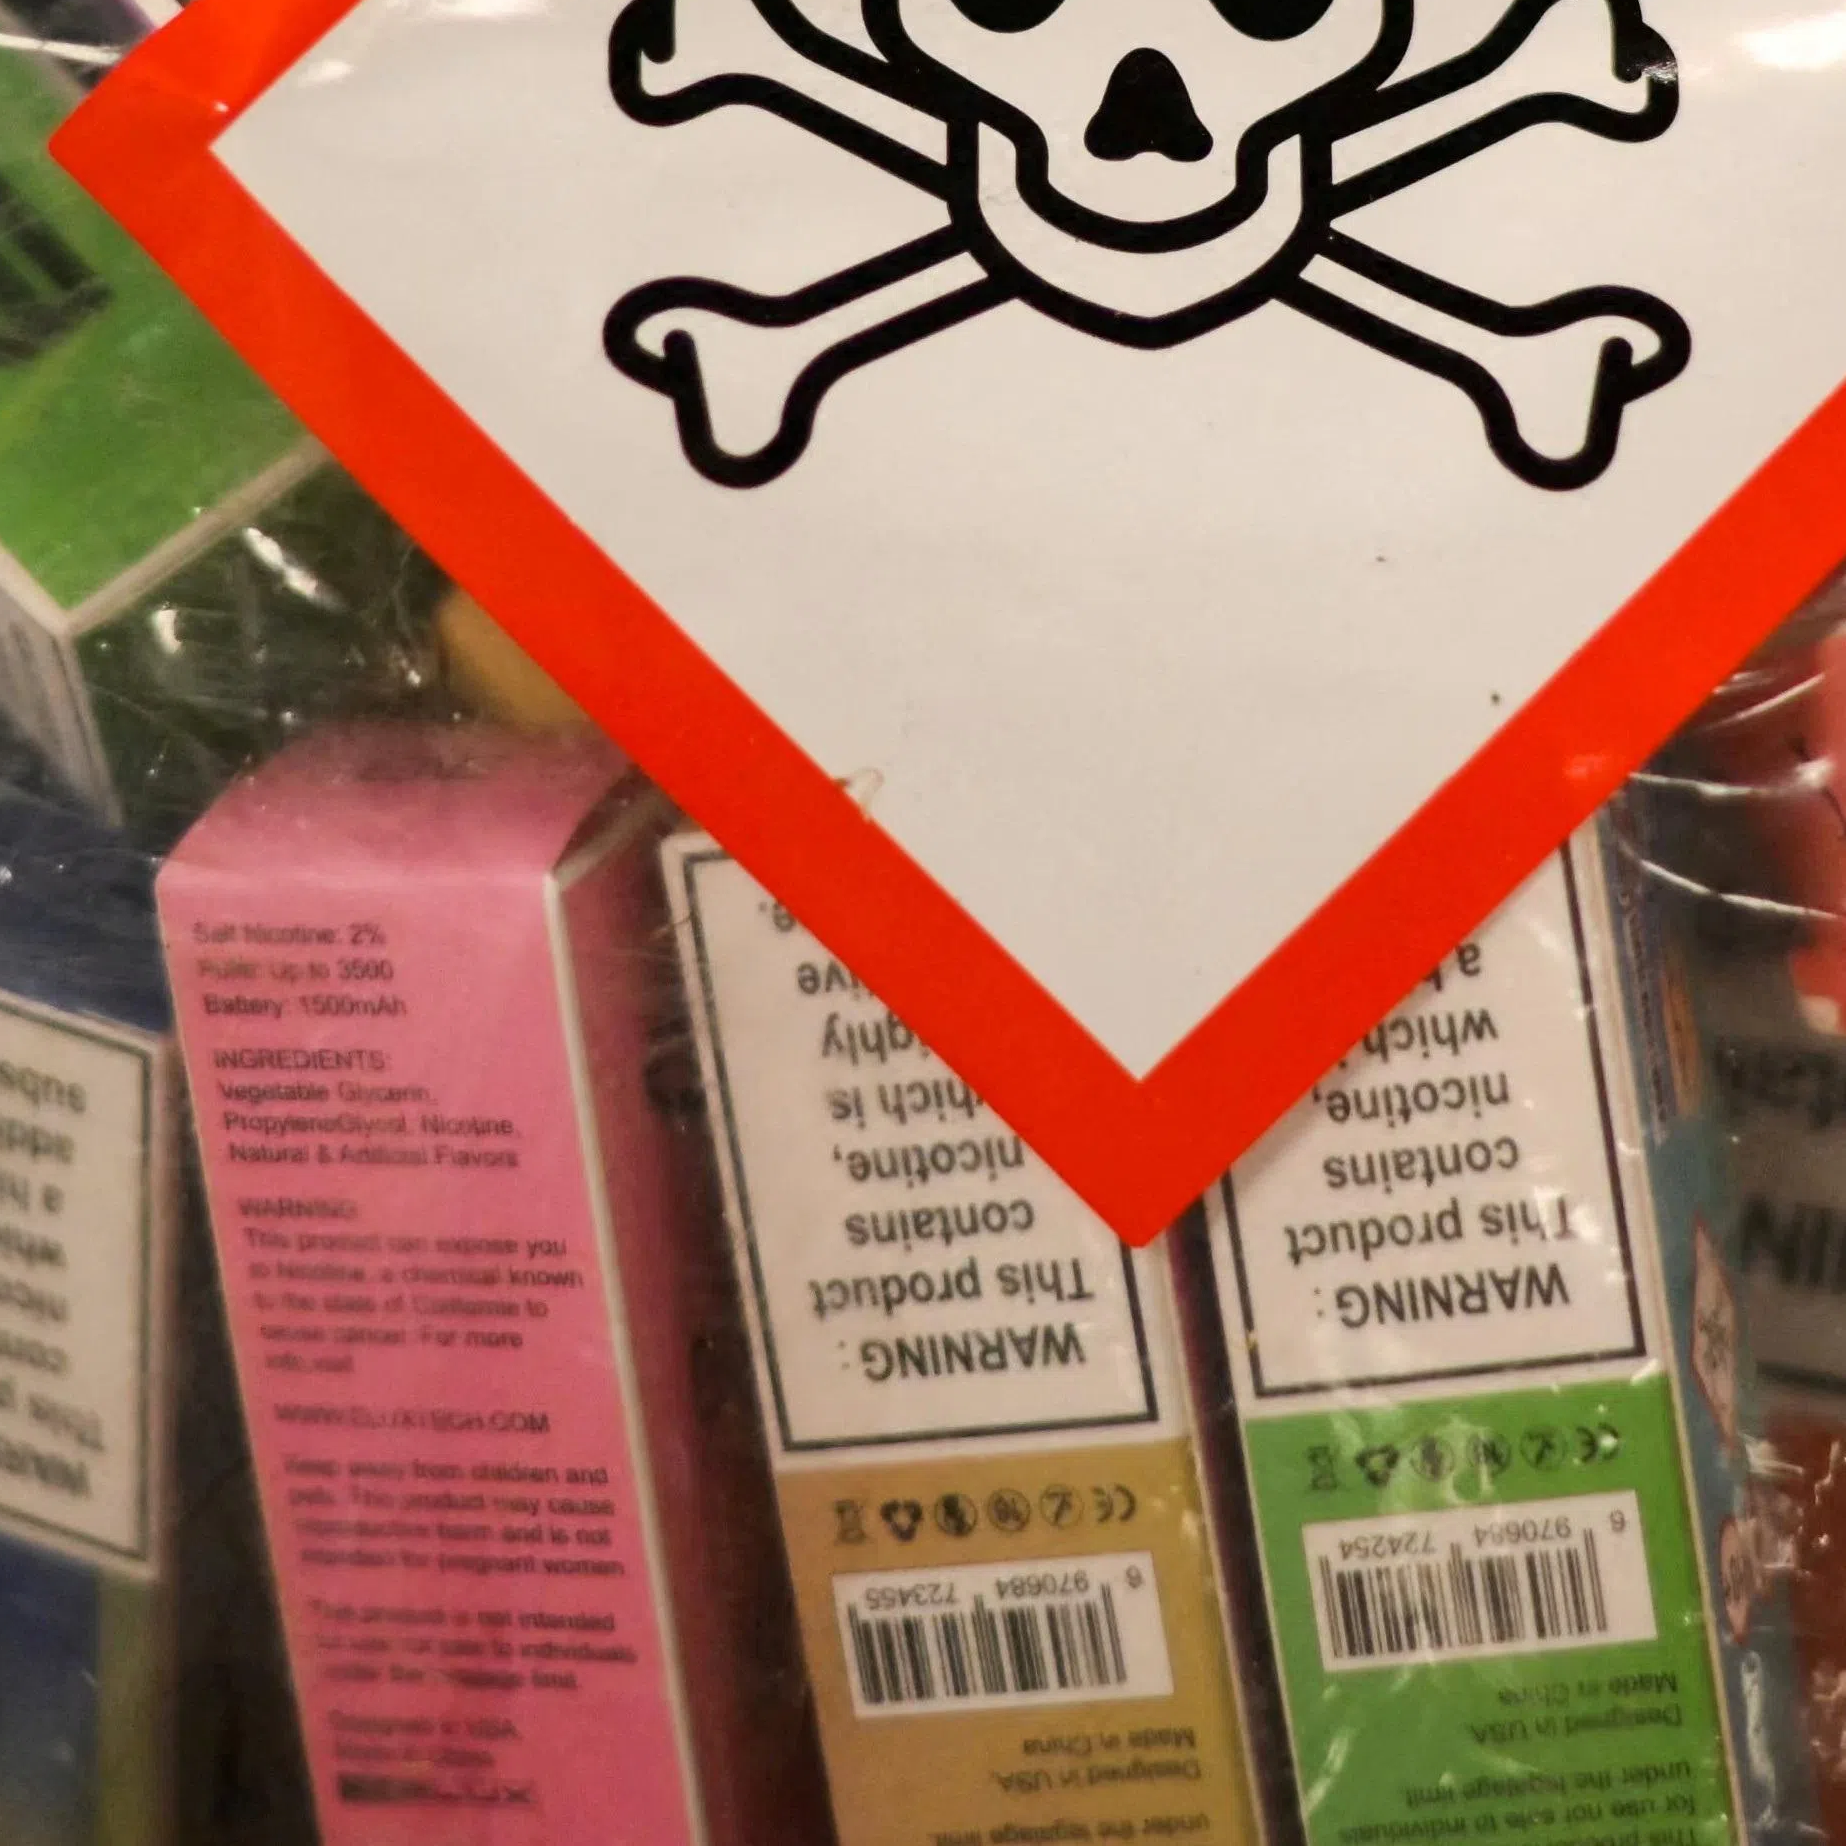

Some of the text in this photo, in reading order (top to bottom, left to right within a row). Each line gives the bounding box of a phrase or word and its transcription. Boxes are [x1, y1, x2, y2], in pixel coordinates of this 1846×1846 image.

[349, 922, 387, 946] 2%
[337, 958, 394, 982] 3500
[1456, 943, 1482, 977] a
[203, 994, 408, 1020] Battery: 1500mAh
[821, 1012, 931, 1067] ghly
[213, 1049, 392, 1072] INGREDIENTS:
[217, 1082, 330, 1106] Vegetable
[829, 1079, 985, 1130] hich is
[1312, 1071, 1511, 1129] nicotine,
[228, 1143, 309, 1164] Natural
[832, 1135, 1025, 1189] nicotine,
[1322, 1135, 1520, 1195] contains
[845, 1198, 1035, 1252] contains
[1284, 1195, 1577, 1266] This product
[434, 1236, 518, 1258] expose
[525, 1238, 567, 1260] you
[508, 1267, 584, 1289] known
[808, 1255, 1096, 1320] This product
[525, 1298, 549, 1318] to
[464, 1330, 523, 1349] more
[565, 1466, 609, 1485] and
[1609, 1509, 1627, 1533] 6
[575, 1527, 612, 1546] not
[1338, 1529, 1437, 1560] 724254
[542, 1557, 626, 1576] women
[865, 1581, 959, 1611] 723455
[995, 1570, 1090, 1601] 970684
[1498, 1682, 1569, 1708] China
[1608, 1671, 1679, 1695] Made
[1023, 1733, 1093, 1757] China
[1128, 1727, 1195, 1749] Made
[1088, 1759, 1201, 1786] Designed
[1573, 1768, 1612, 1792] the
[1622, 1760, 1692, 1788] under
[1611, 1798, 1653, 1818] use
[1665, 1794, 1697, 1817] for
[1143, 1813, 1210, 1836] under
